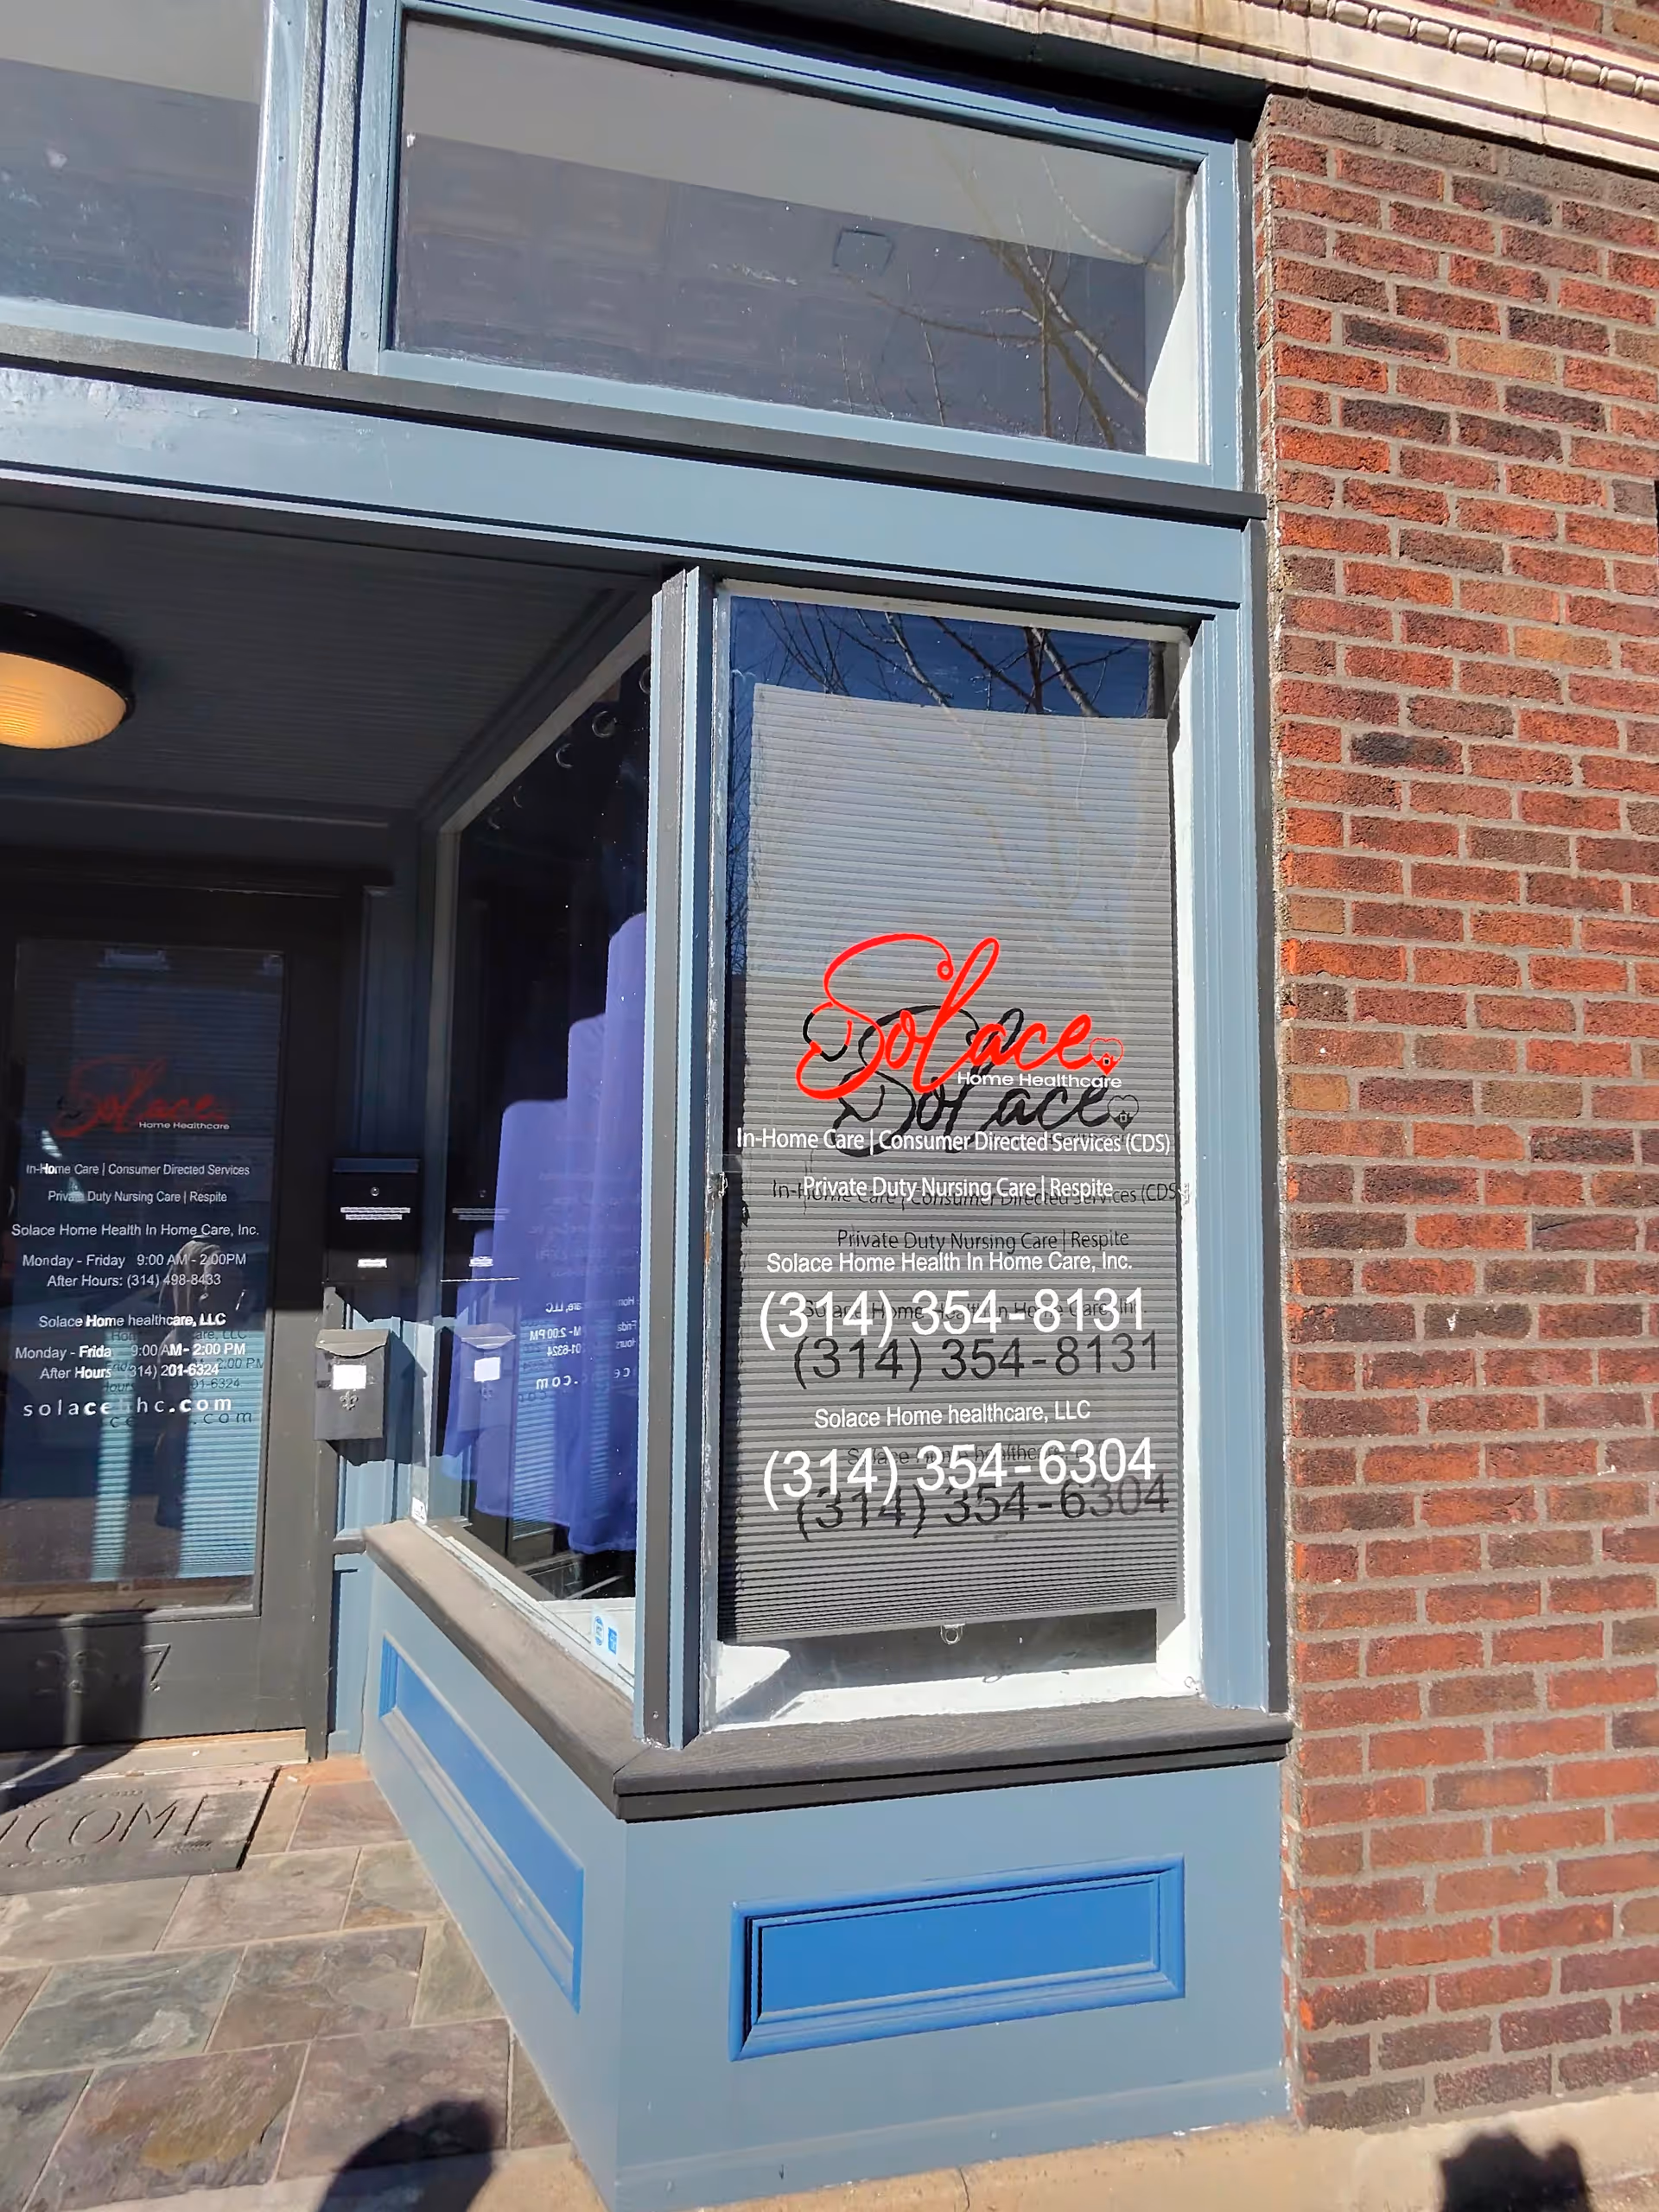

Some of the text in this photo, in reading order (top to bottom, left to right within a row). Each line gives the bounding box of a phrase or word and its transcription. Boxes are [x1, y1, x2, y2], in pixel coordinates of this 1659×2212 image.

[796, 933, 1092, 1100] Solace
[957, 1072, 1122, 1089] Home Healthcare
[173, 1122, 230, 1130] Healthcare
[736, 1127, 818, 1148] In-Home
[823, 1129, 864, 1149] Care
[879, 1129, 970, 1150] Consumer
[975, 1131, 1048, 1152] Directed
[1052, 1133, 1122, 1153] Services
[1126, 1133, 1170, 1154] (CDS)
[26, 1163, 71, 1175] In-Home
[74, 1163, 99, 1175] Care
[108, 1164, 161, 1175] Consumer
[163, 1163, 205, 1175] Directed
[207, 1164, 250, 1176] Services
[804, 1175, 868, 1197] Private
[872, 1176, 917, 1200] Duty
[922, 1178, 991, 1201] Nursing
[996, 1178, 1036, 1198] Care
[1050, 1178, 1114, 1202] Respite
[87, 1190, 111, 1205] Duty
[114, 1191, 153, 1205] Nursing
[156, 1191, 181, 1202] Care
[189, 1191, 227, 1205] Respite
[11, 1224, 259, 1237] Solace Home Health In Home Care, Inc.
[22, 1255, 74, 1269] Monday
[86, 1254, 126, 1269] Friday
[137, 1254, 164, 1266] 9:00
[166, 1254, 188, 1265] AM
[200, 1253, 246, 1265] 200PM
[766, 1250, 1133, 1273] Solace Home Health In Home Care, Inc.
[47, 1274, 222, 1288] After Hours: (314) 498-8433
[38, 1313, 226, 1328] Solace Home healthcare, LLC
[760, 1289, 893, 1351] (314)
[912, 1287, 1143, 1336] 354-8131
[15, 1346, 67, 1361] Monday
[130, 1344, 157, 1357] 9:00
[192, 1343, 220, 1356] 2:00
[224, 1343, 246, 1356] PM
[40, 1366, 72, 1380] After
[130, 1364, 157, 1380] 314)
[161, 1363, 219, 1376] 201-6324
[814, 1399, 1091, 1428] Solace Home healthcare, LLC
[763, 1436, 1156, 1511] (314) 354-6304
